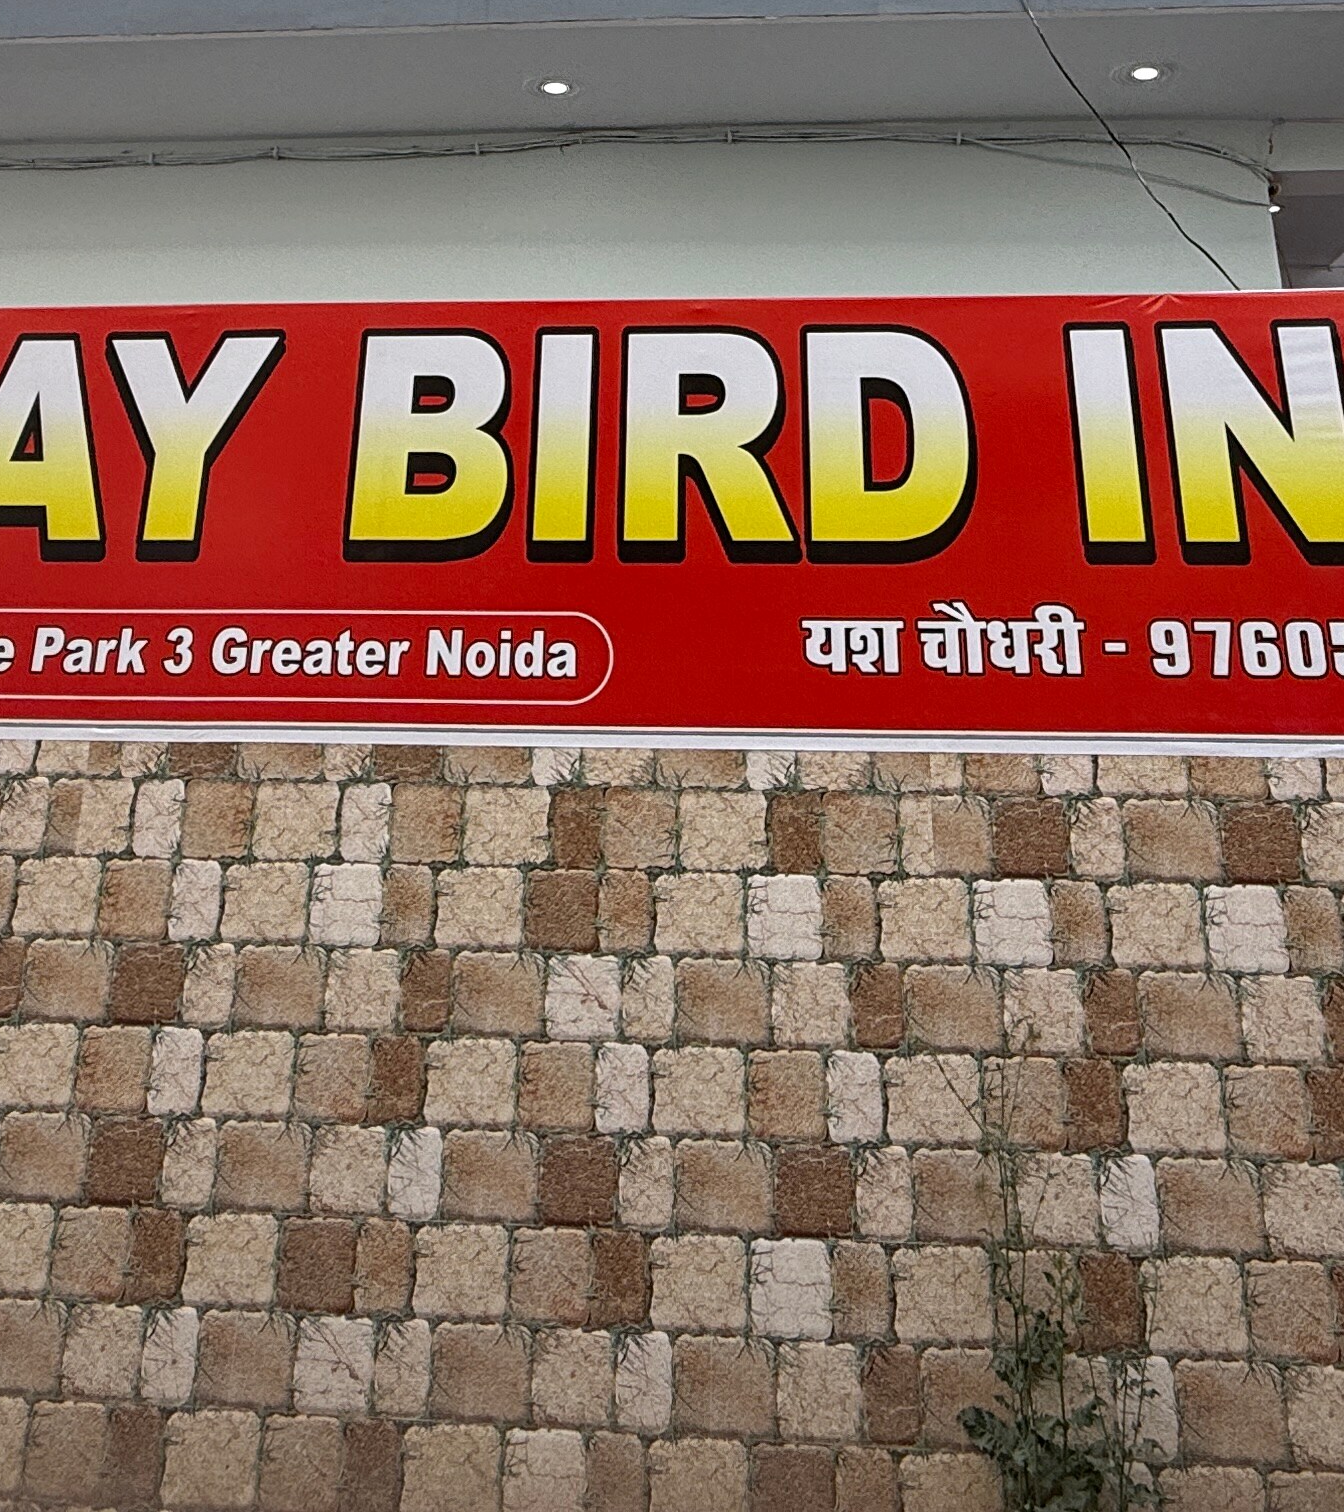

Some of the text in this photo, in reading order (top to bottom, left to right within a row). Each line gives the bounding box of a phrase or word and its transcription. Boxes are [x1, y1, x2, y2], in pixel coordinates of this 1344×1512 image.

[343, 326, 978, 563] BIRD
[29, 626, 149, 676] Park
[162, 626, 195, 676] 3
[210, 626, 411, 677] Greater
[423, 628, 578, 678] Noida
[801, 619, 905, 674] यश
[916, 600, 1085, 676] चौधरी
